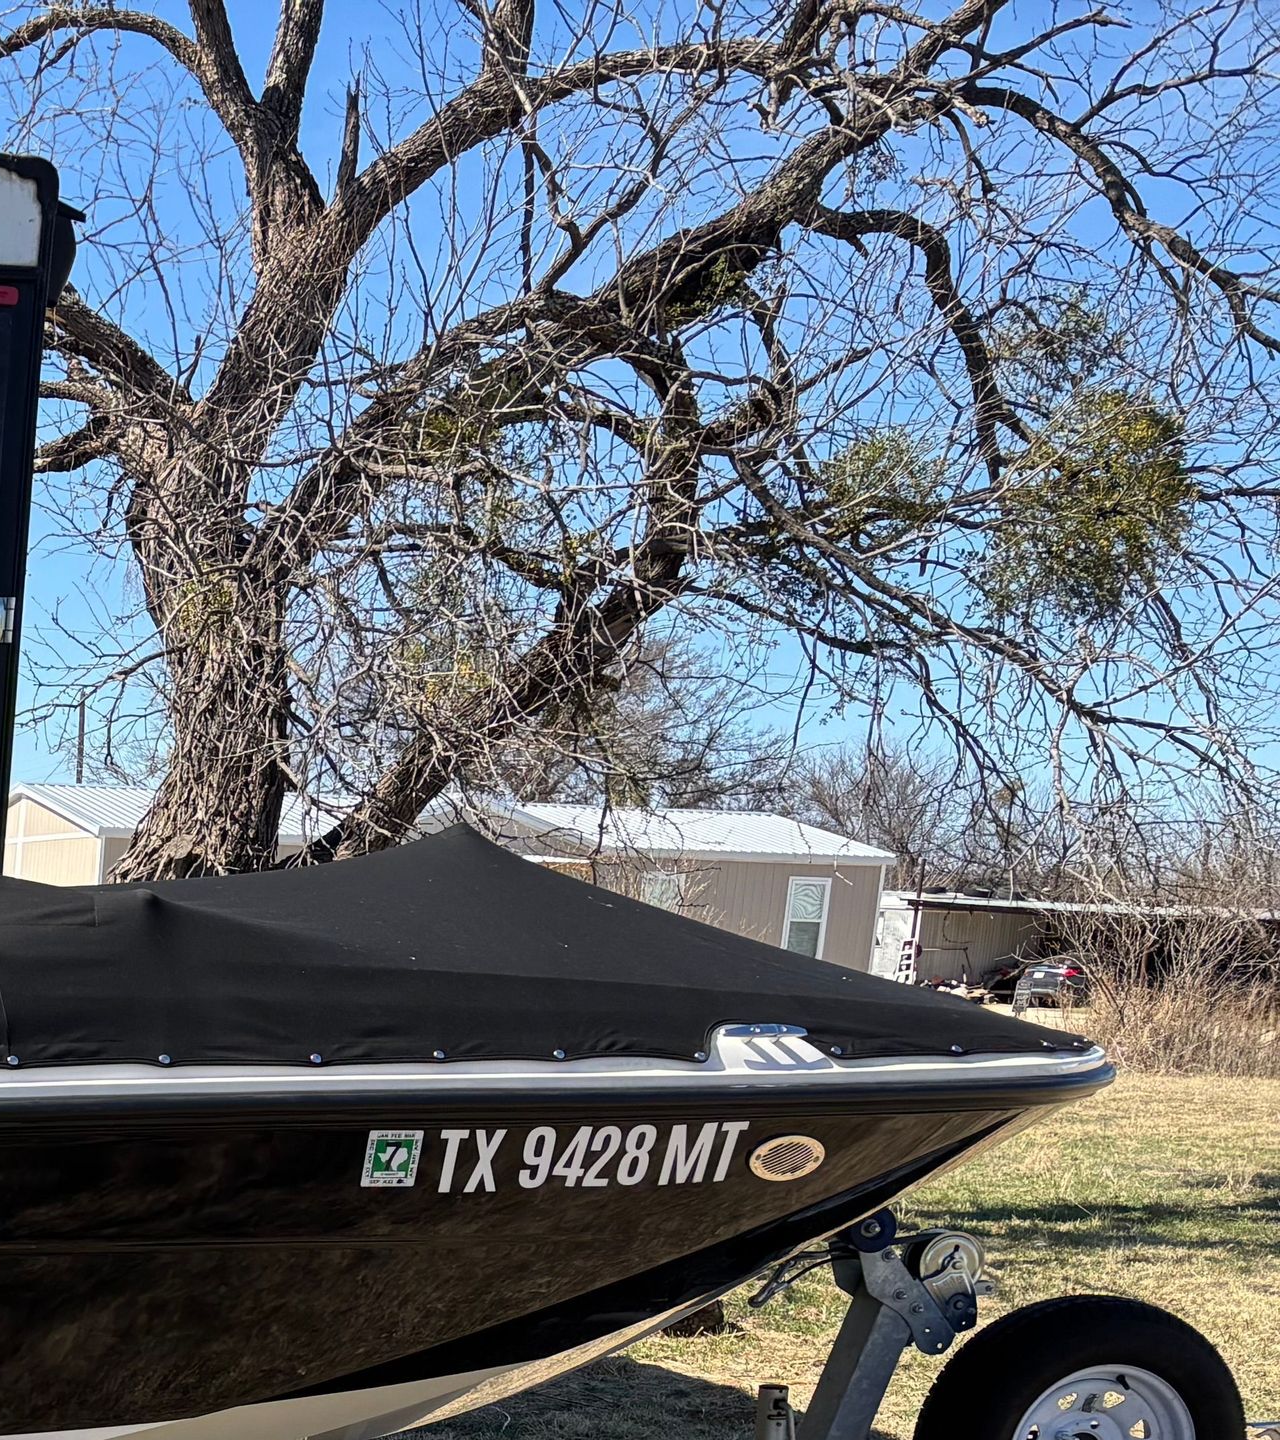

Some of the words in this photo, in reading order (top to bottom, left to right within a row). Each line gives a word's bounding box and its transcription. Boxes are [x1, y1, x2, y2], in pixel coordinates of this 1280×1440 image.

[384, 1141, 402, 1171] 7
[437, 1129, 508, 1193] TX
[517, 1124, 659, 1189] 9428
[657, 1121, 750, 1187] MT
